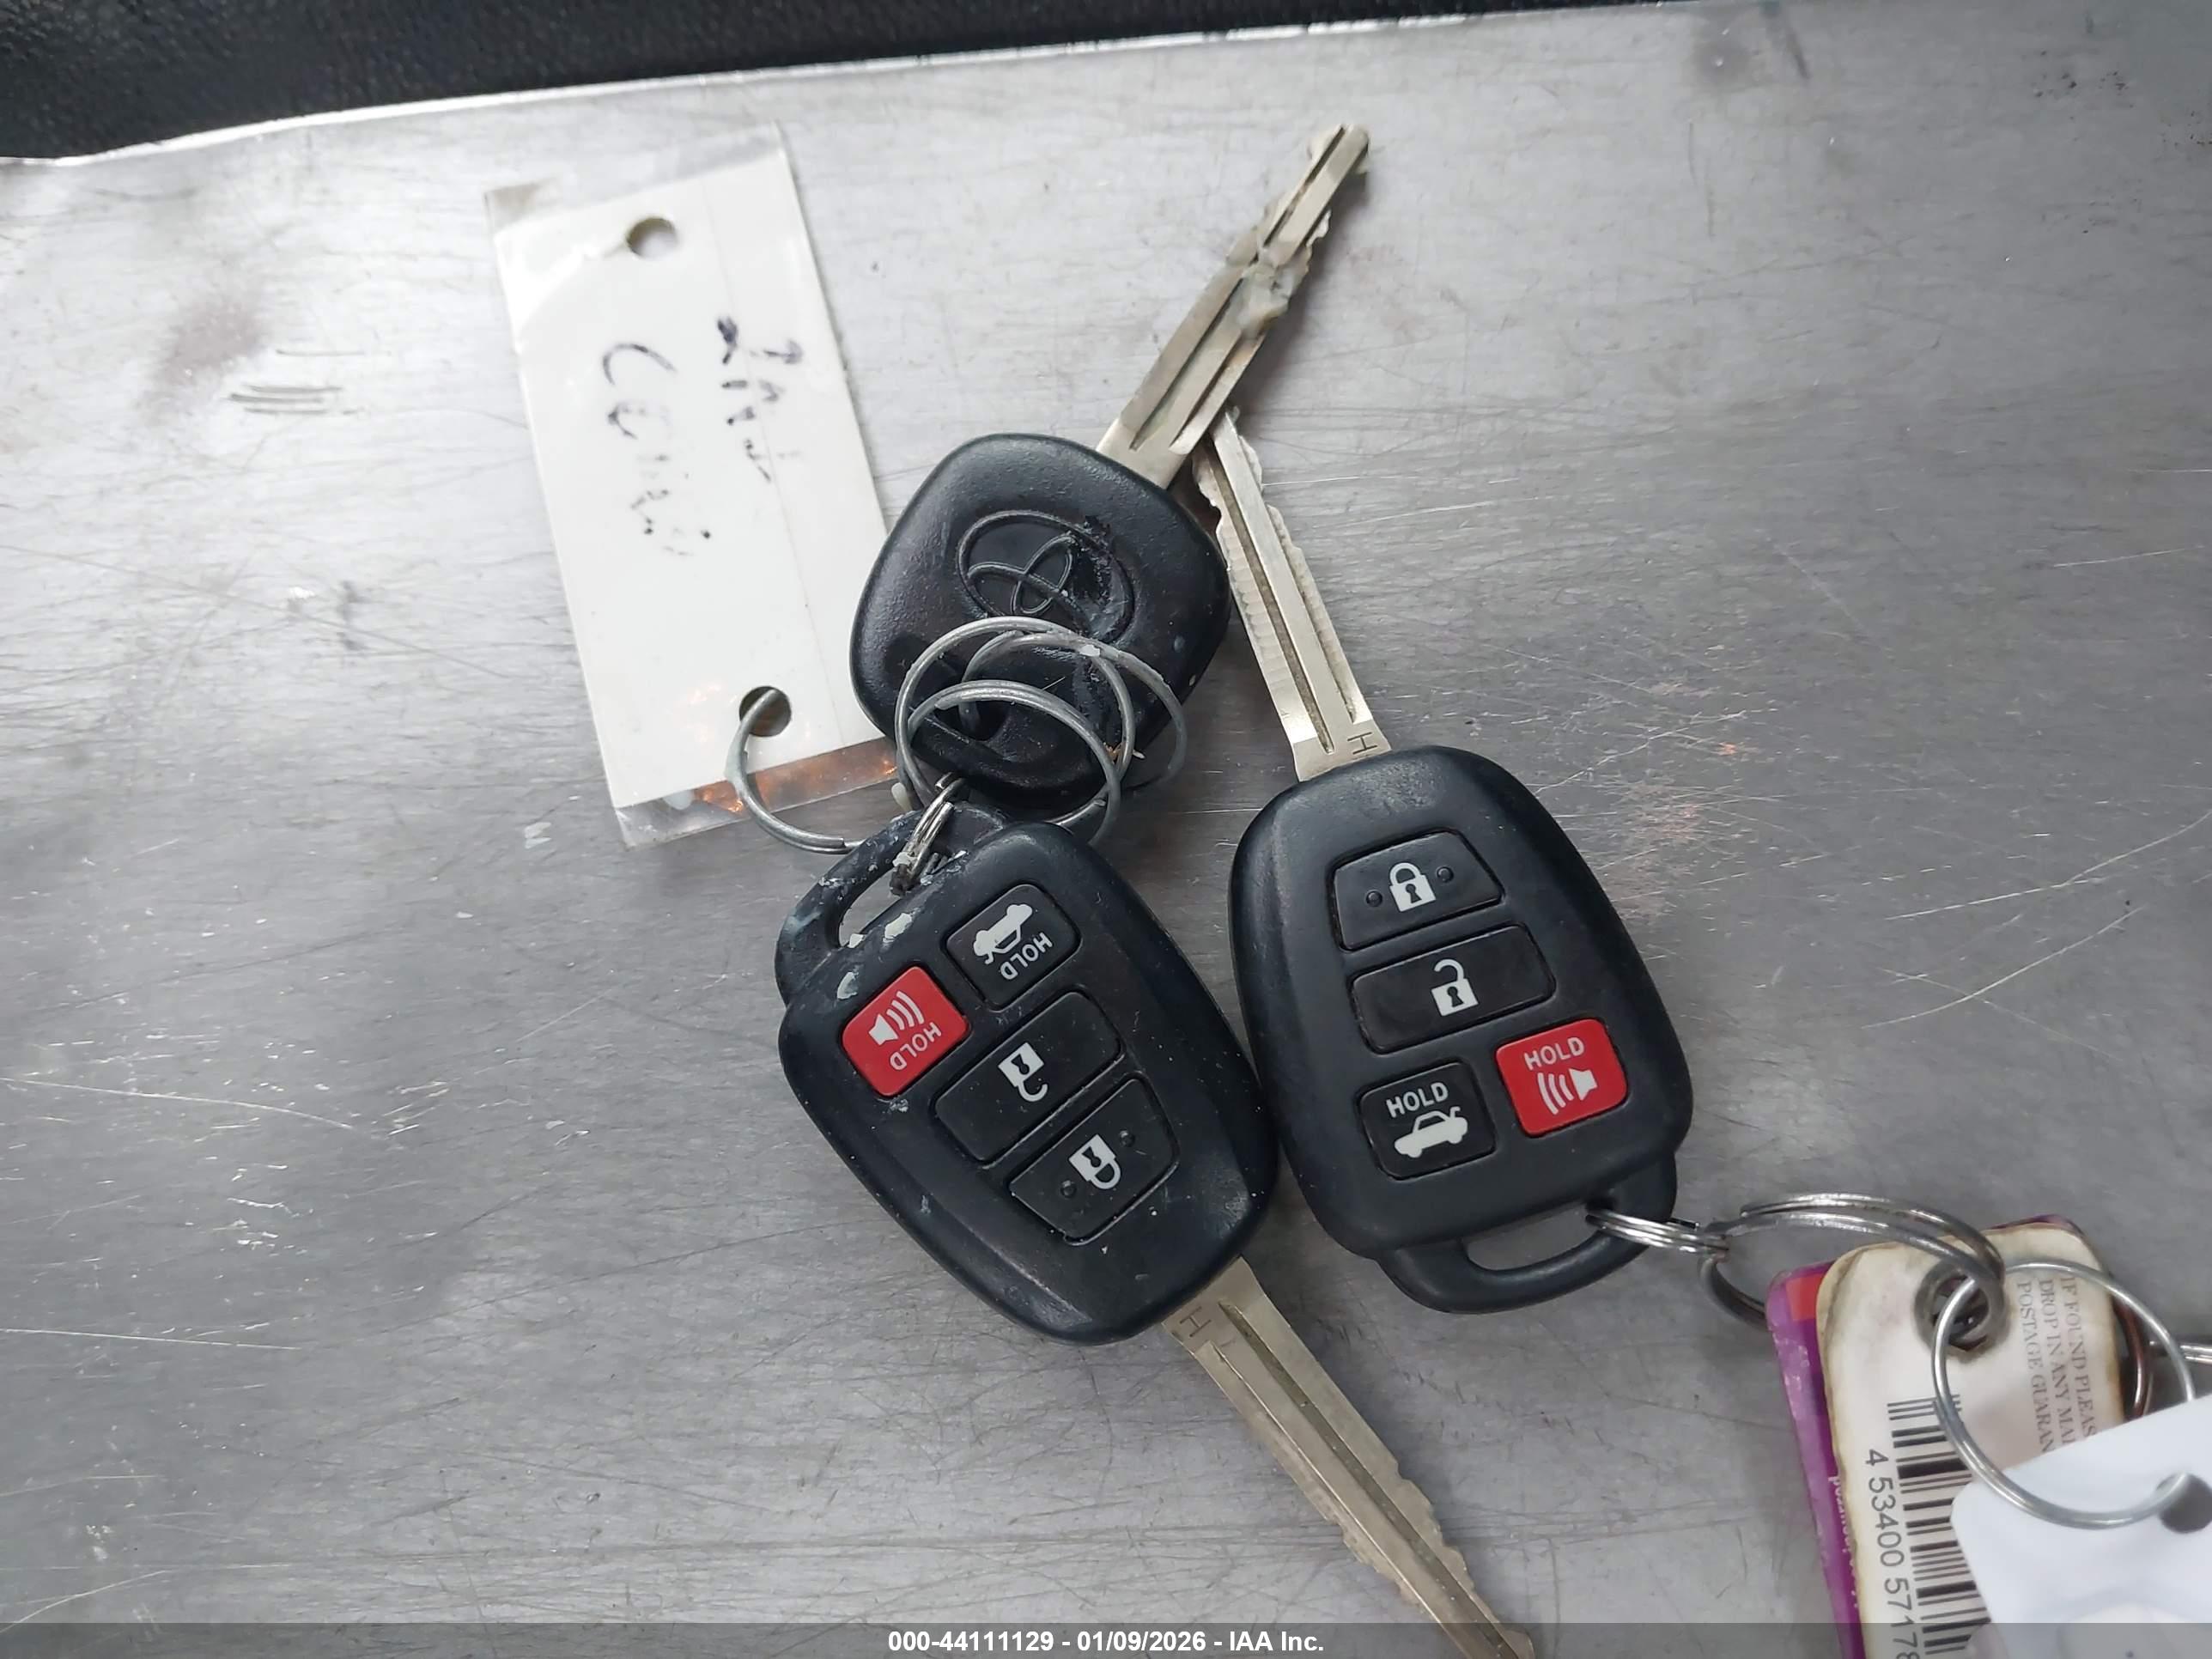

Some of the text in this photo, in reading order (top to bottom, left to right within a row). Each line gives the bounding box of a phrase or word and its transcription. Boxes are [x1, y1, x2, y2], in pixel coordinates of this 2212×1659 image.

[1000, 931, 1054, 981] HOLD
[888, 1021, 942, 1071] HOLD
[1523, 1036, 1585, 1070] HOLD
[1385, 1080, 1449, 1118] HOLD
[2016, 1280, 2057, 1454] POSTAGE GUARAN
[2039, 1279, 2076, 1446] DROP IN ANY MAI
[2060, 1274, 2097, 1438] IF FOUND PLEAS
[1865, 1449, 1889, 1467] 4
[1868, 1476, 1905, 1567] 53400
